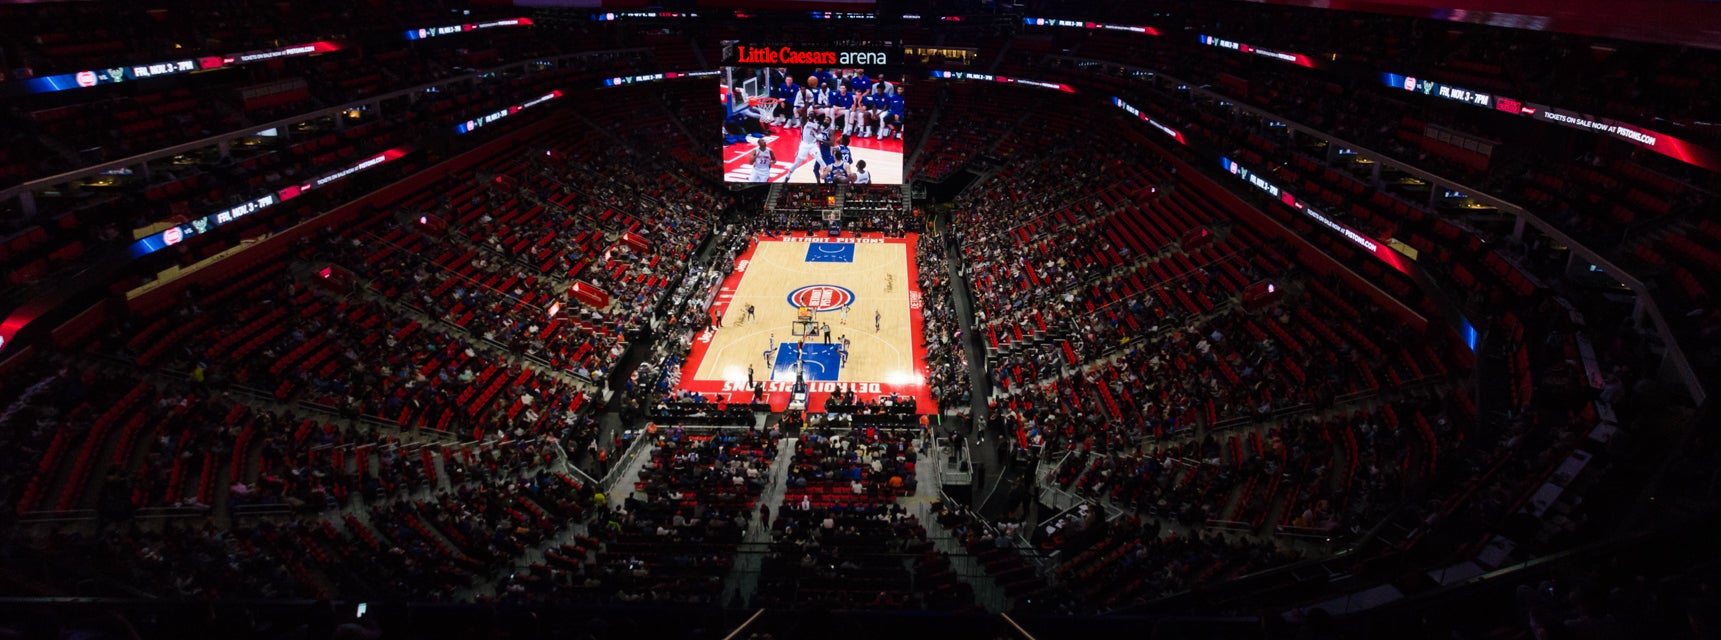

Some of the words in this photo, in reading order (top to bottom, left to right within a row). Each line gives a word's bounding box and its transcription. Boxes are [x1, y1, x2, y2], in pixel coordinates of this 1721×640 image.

[738, 46, 778, 62] Little
[779, 47, 836, 64] Caesars
[839, 52, 886, 65] arena
[166, 63, 174, 72] 3
[177, 60, 194, 71] 7PM
[1439, 85, 1450, 98] FRI,
[1450, 88, 1465, 101] NOV.
[1464, 91, 1470, 102] 3
[1474, 93, 1489, 106] 7PM
[1544, 111, 1566, 122] TICKETS
[1566, 116, 1576, 124] ON
[1576, 118, 1592, 127] SALE
[1591, 122, 1608, 131] NOW
[1616, 126, 1656, 146] PISTONS.COM
[248, 202, 255, 212] 3
[257, 195, 273, 209] 7PM
[1345, 229, 1377, 253] PISTONS.COM
[809, 382, 882, 394] DETROIT
